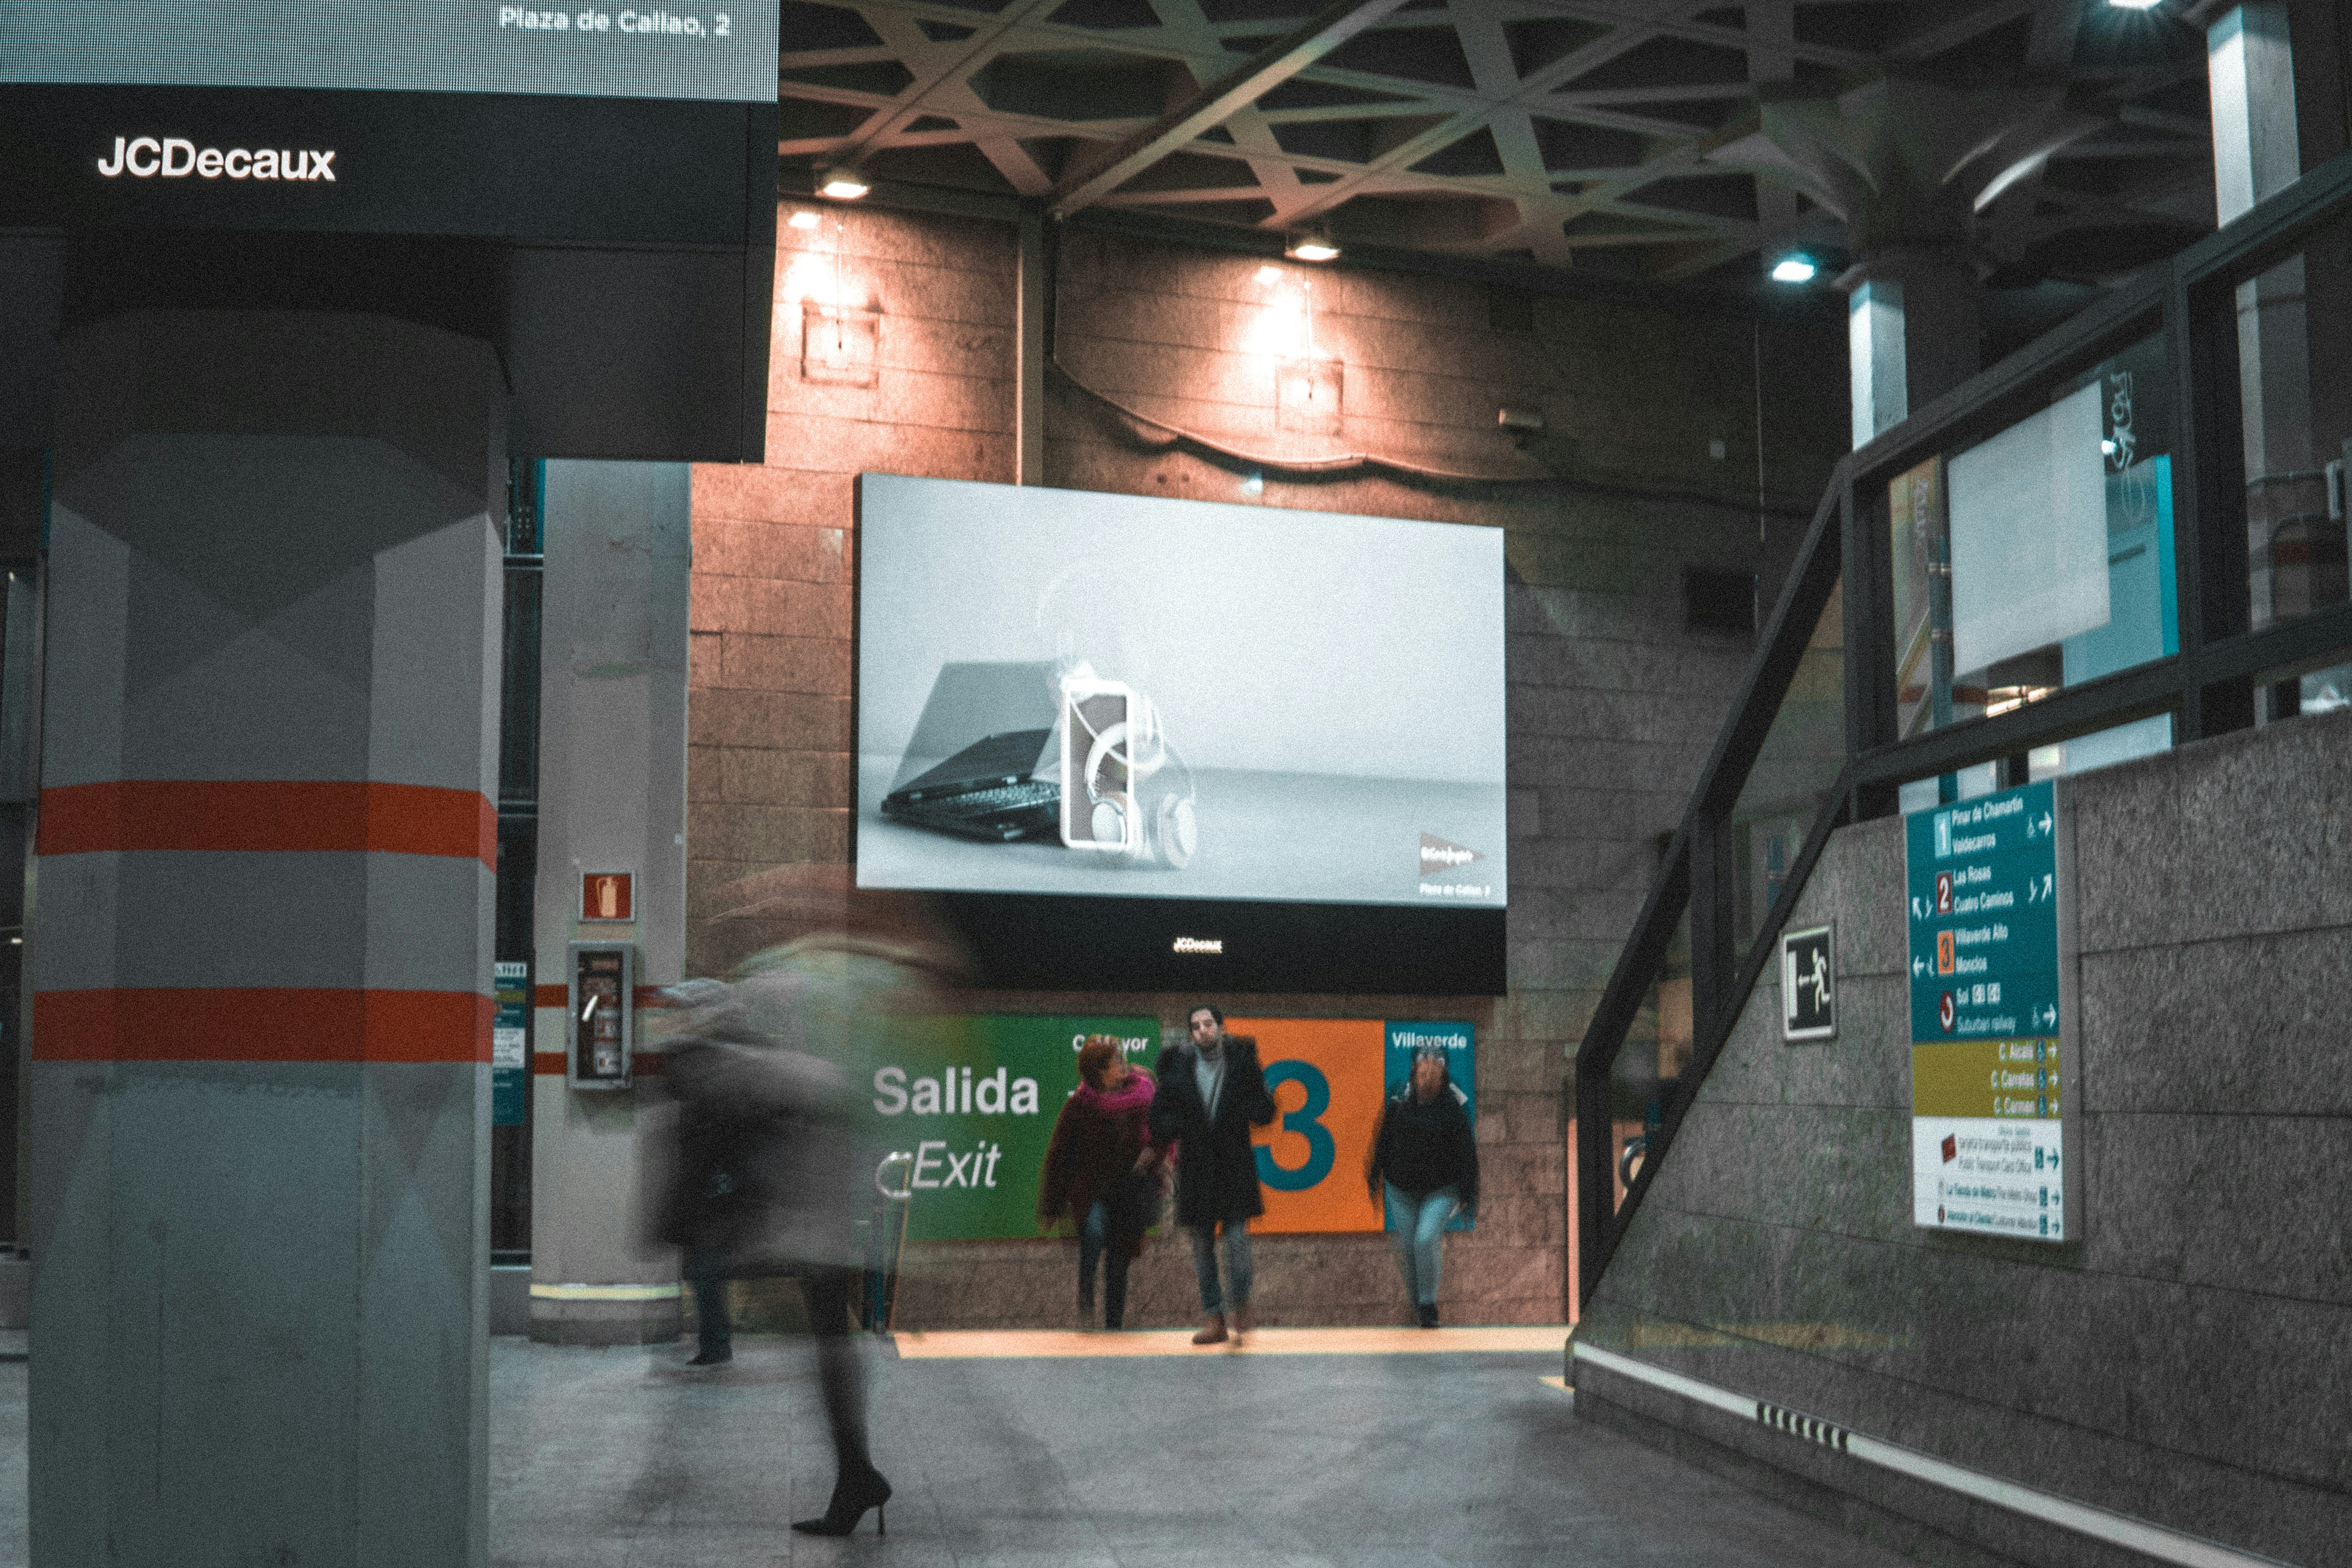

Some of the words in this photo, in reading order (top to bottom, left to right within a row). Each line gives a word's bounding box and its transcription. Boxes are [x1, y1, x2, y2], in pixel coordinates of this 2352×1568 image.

[501, 5, 569, 31] Plaza
[577, 8, 610, 32] de
[716, 12, 730, 36] 2
[98, 136, 336, 181] JCDecaux
[1972, 806, 1982, 824] de
[1940, 877, 1949, 910] 2
[1953, 869, 1966, 886] Las
[1941, 936, 1950, 969] 3
[1392, 1031, 1468, 1049] Villaverde
[873, 1065, 1039, 1116] Salida
[1252, 1059, 1336, 1192] 3
[912, 1140, 1002, 1188] Exit
